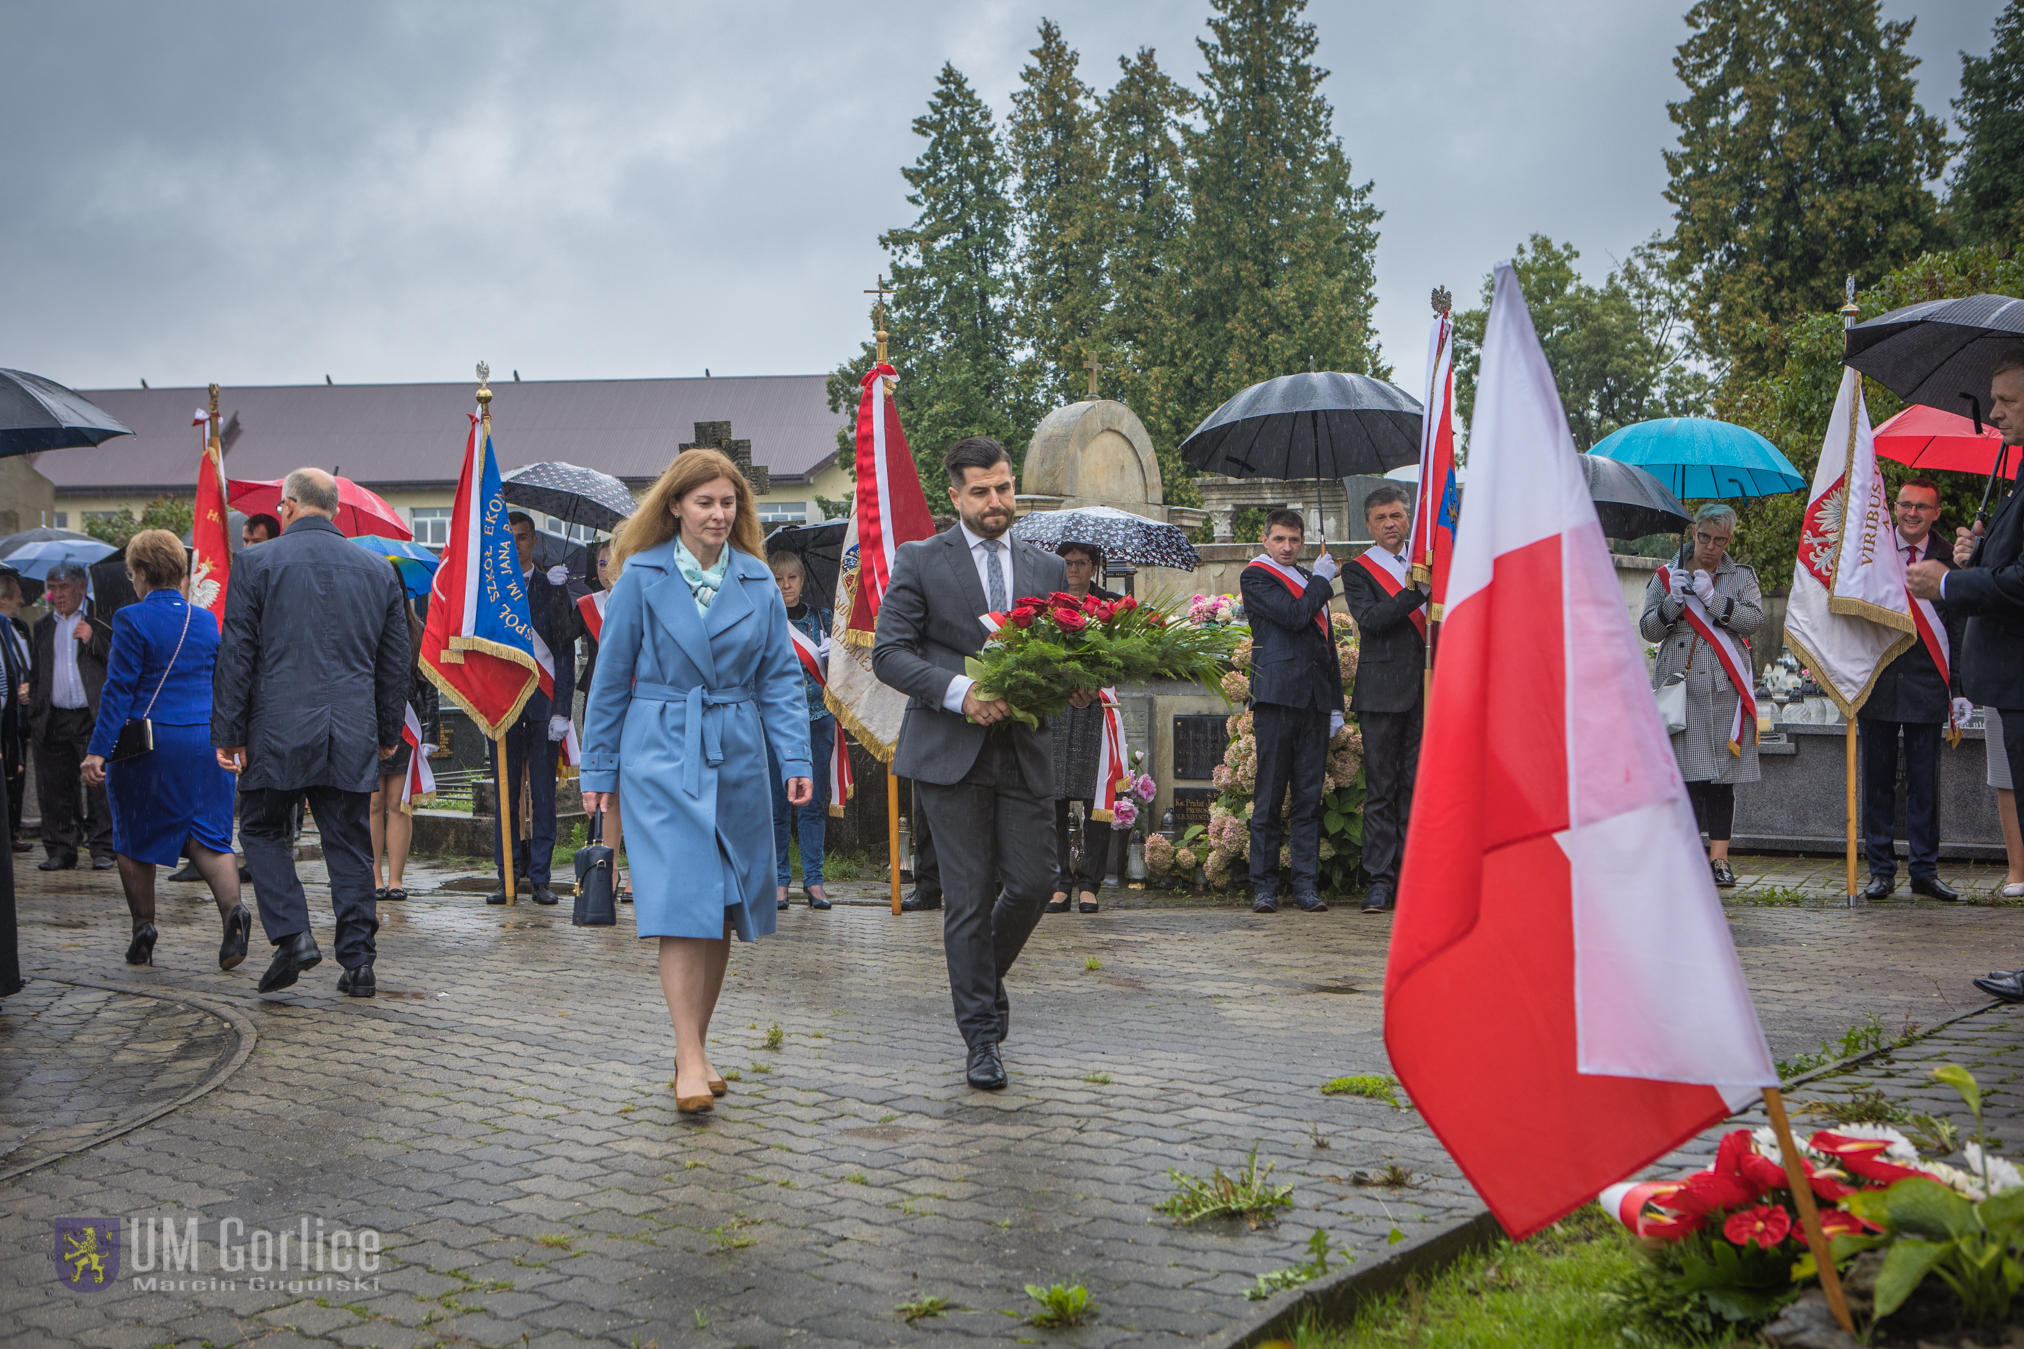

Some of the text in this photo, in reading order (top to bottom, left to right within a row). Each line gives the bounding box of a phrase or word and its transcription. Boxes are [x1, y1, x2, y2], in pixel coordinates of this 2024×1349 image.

[1860, 482, 1882, 567] VIRIBUS
[483, 488, 534, 643] SPÓŁ SZKÓŁ EKON
[498, 541, 513, 575] JANA
[506, 579, 524, 602] IM.
